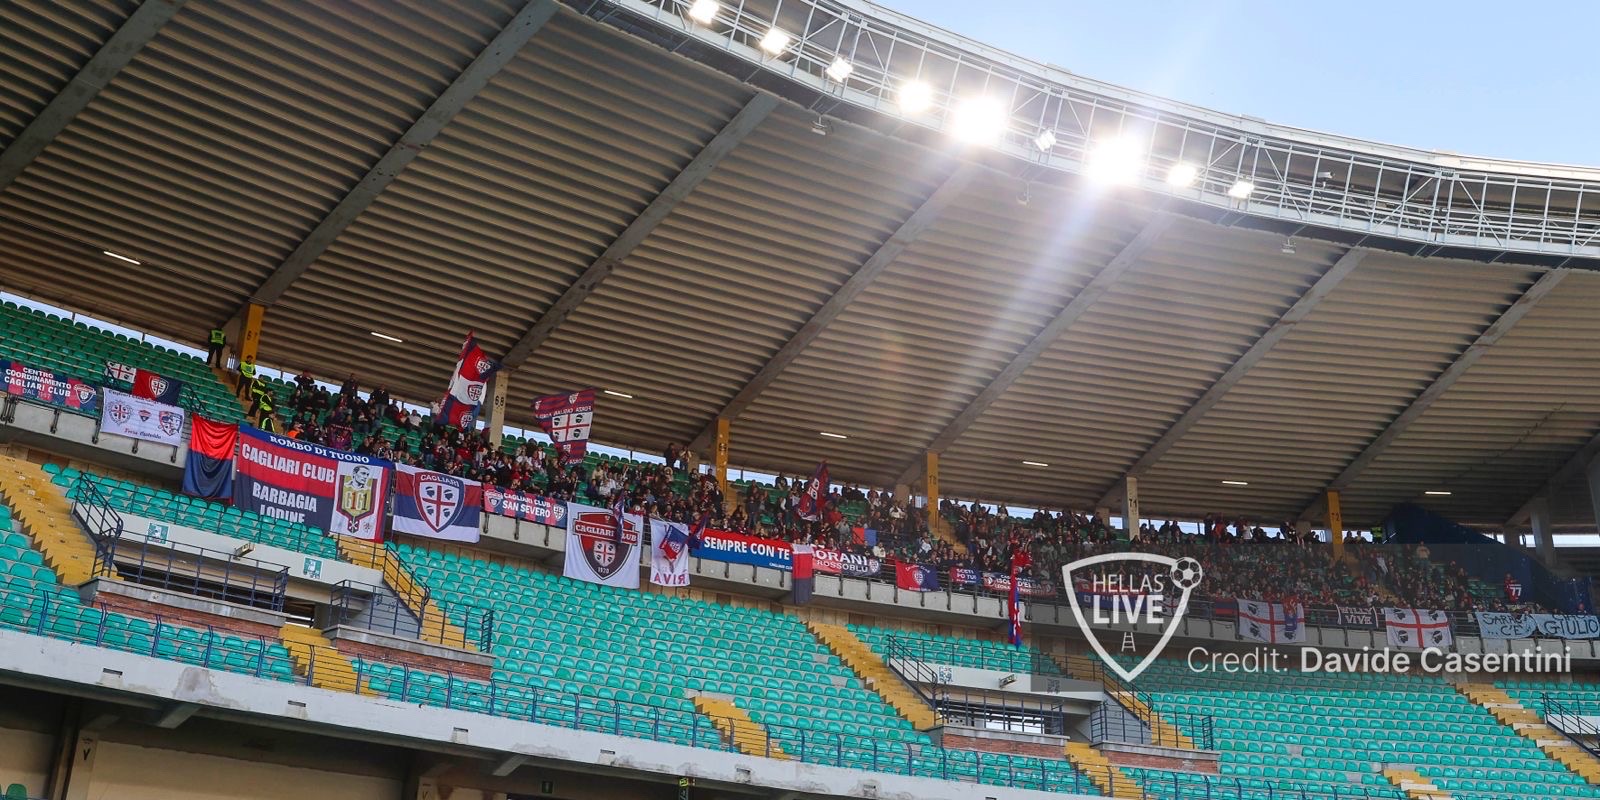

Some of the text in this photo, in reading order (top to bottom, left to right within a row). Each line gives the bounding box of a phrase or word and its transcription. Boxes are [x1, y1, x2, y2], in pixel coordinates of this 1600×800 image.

[5, 369, 72, 390] COORDINAMENTO
[23, 367, 54, 379] CENTRO
[4, 376, 46, 392] CAGLIARI
[48, 386, 71, 397] CLUB
[495, 395, 504, 406] 68
[270, 435, 370, 464] ROMBO DI TUONO
[241, 443, 336, 483] CAGLIARI CLUB
[420, 474, 460, 487] CAGLIARI
[252, 481, 317, 513] BARBAGIA
[503, 492, 533, 504] CAGLIARI
[534, 499, 551, 507] CLUB
[502, 500, 551, 518] SAN SEVERO
[575, 524, 638, 542] CAGLIARI LUB
[703, 536, 790, 561] SEMPRE CON TE
[812, 549, 868, 566] ORANI
[816, 560, 869, 573] ROSSOBLU
[1510, 587, 1522, 596] 77
[1345, 614, 1373, 625] VIVE
[1544, 619, 1598, 635] GIULIO
